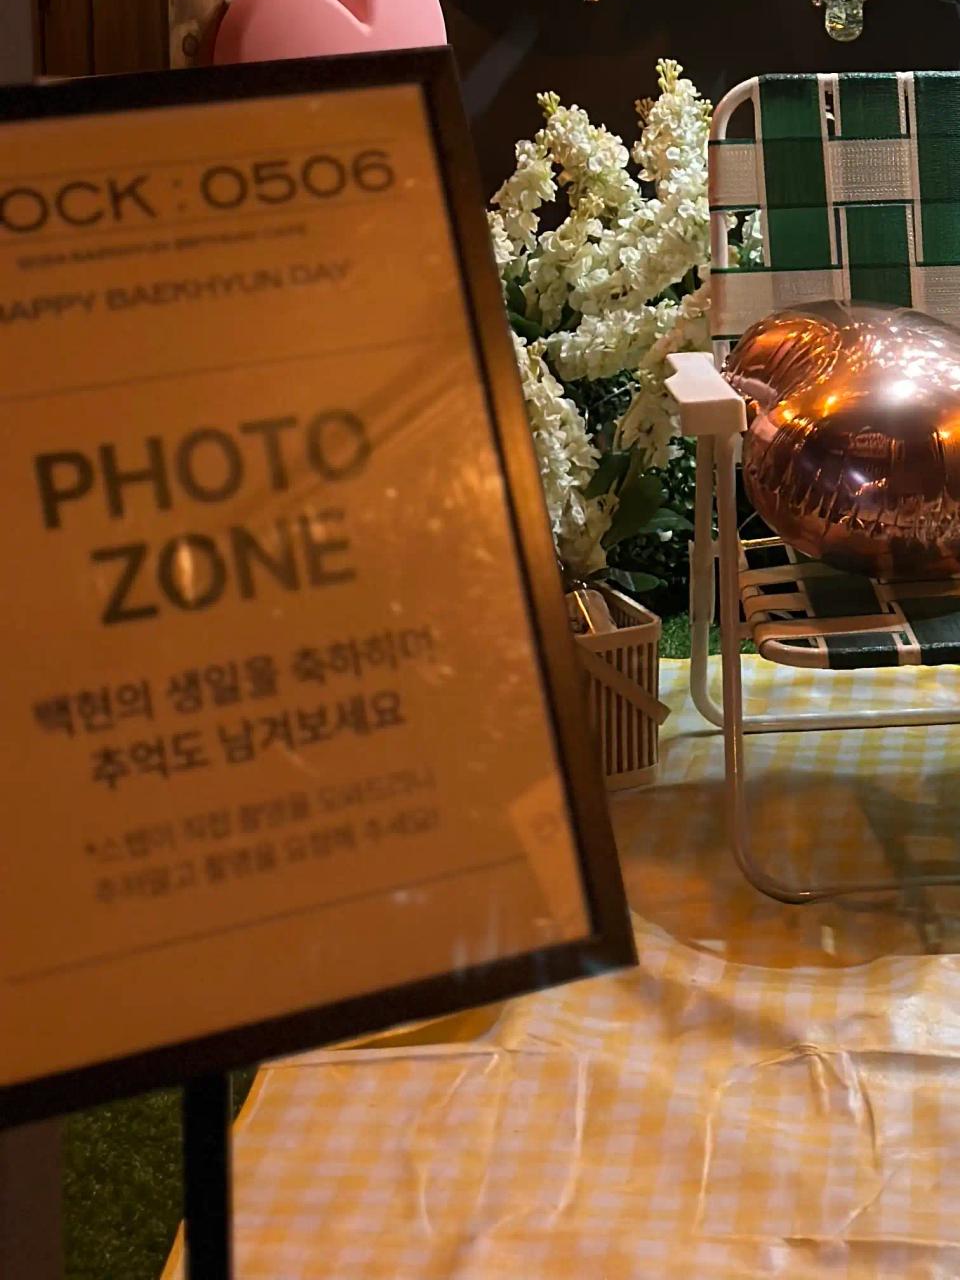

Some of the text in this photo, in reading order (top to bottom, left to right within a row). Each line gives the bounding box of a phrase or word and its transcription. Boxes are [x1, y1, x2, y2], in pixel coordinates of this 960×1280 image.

[33, 408, 372, 530] PHOTO
[89, 507, 358, 628] ZONE
[91, 730, 210, 790] 추억도
